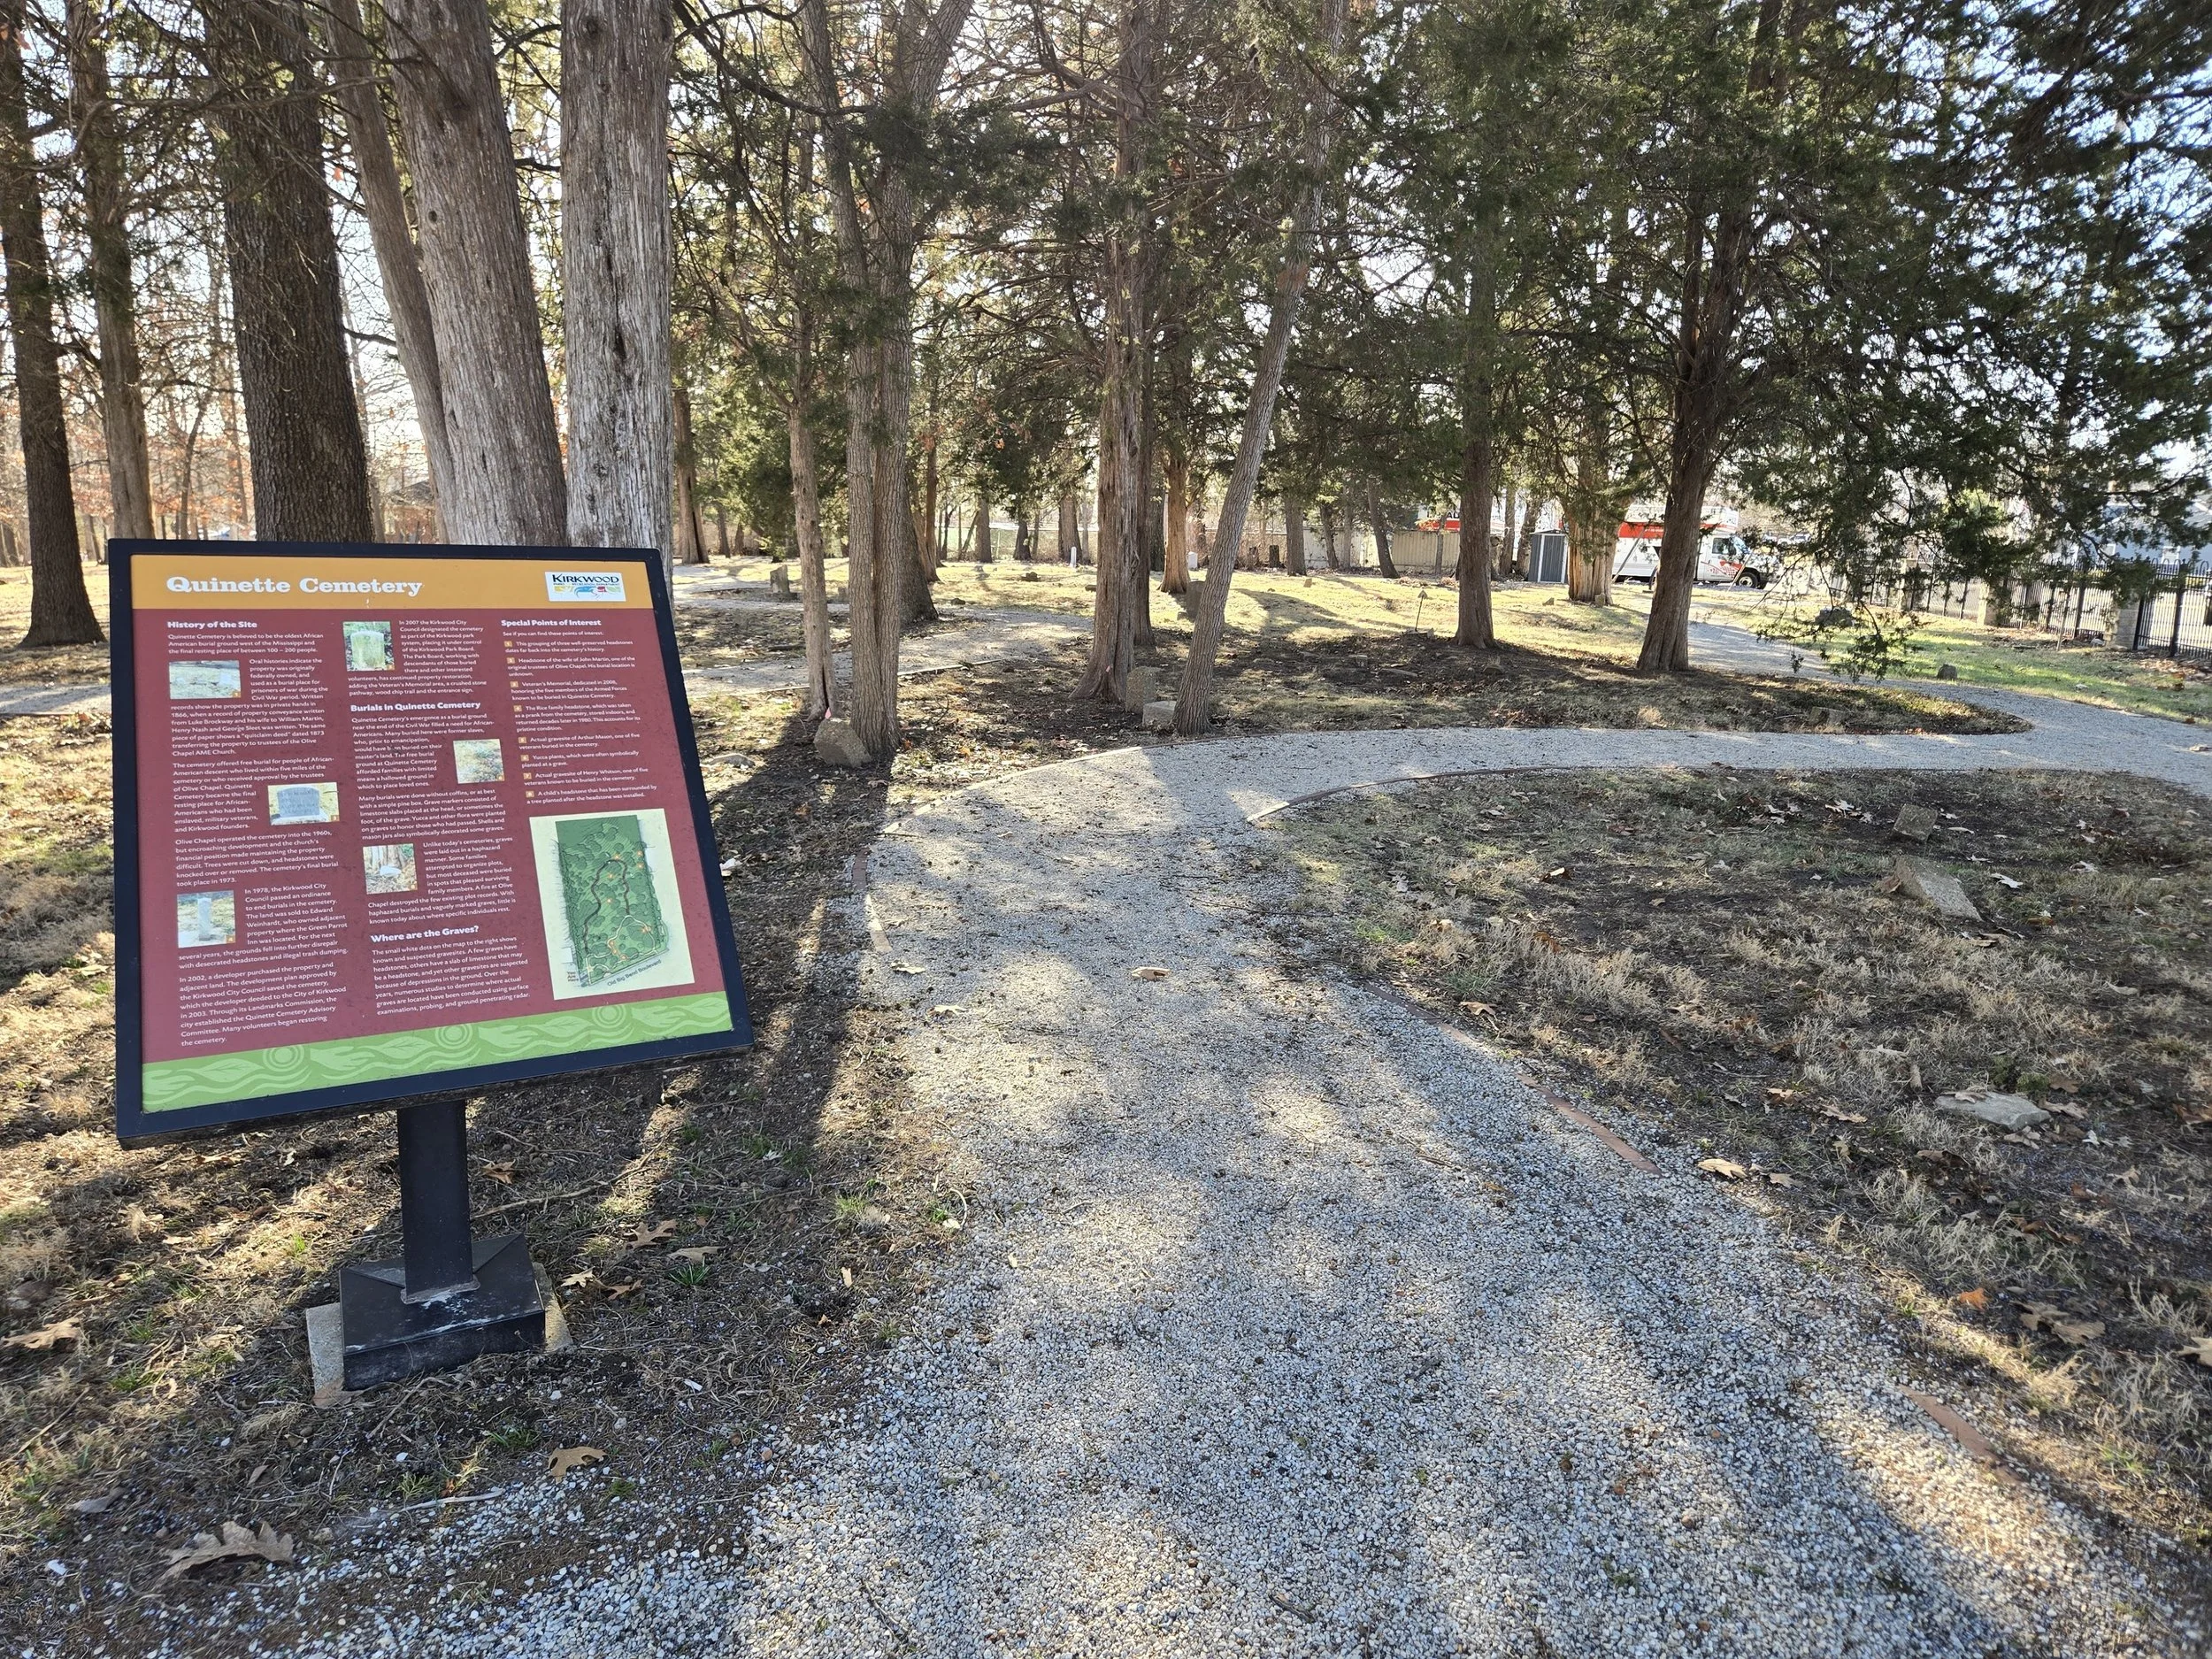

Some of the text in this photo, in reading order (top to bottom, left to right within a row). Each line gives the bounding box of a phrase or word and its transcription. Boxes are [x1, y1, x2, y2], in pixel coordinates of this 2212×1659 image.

[165, 576, 422, 596] Quinette Cemetery
[552, 573, 619, 583] KIRKWOOD
[370, 933, 404, 942] Where
[442, 925, 479, 935] Graves?
[638, 959, 661, 972] Boulevard
[376, 1006, 419, 1015] examinations,
[419, 1002, 444, 1011] probing,
[457, 997, 479, 1007] ground
[479, 995, 512, 1004] penetrating
[180, 1028, 220, 1037] Committee.
[242, 1021, 276, 1030] volunteers
[194, 1017, 232, 1026] established
